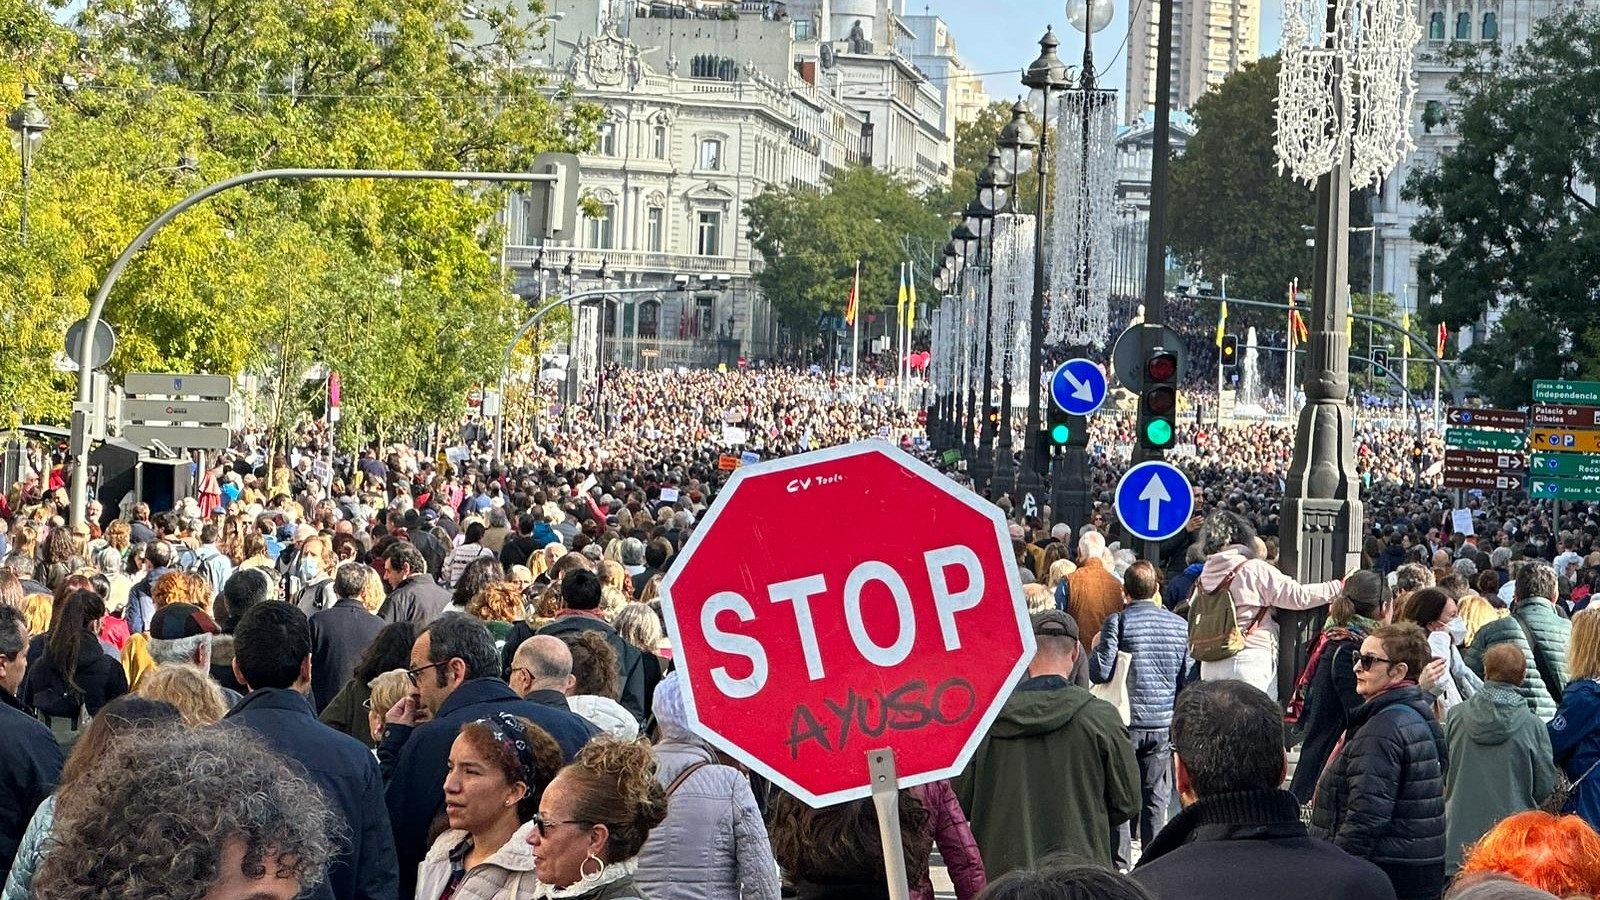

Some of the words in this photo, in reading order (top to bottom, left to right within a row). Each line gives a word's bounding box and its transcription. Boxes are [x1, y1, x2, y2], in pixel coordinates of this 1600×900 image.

[1536, 390, 1598, 399] Independencia
[1535, 415, 1564, 423] Cibeles
[1563, 435, 1574, 446] P
[786, 476, 811, 493] CV
[1476, 477, 1495, 485] Prado
[700, 544, 985, 698] STOP
[784, 678, 975, 760] AYUSO
